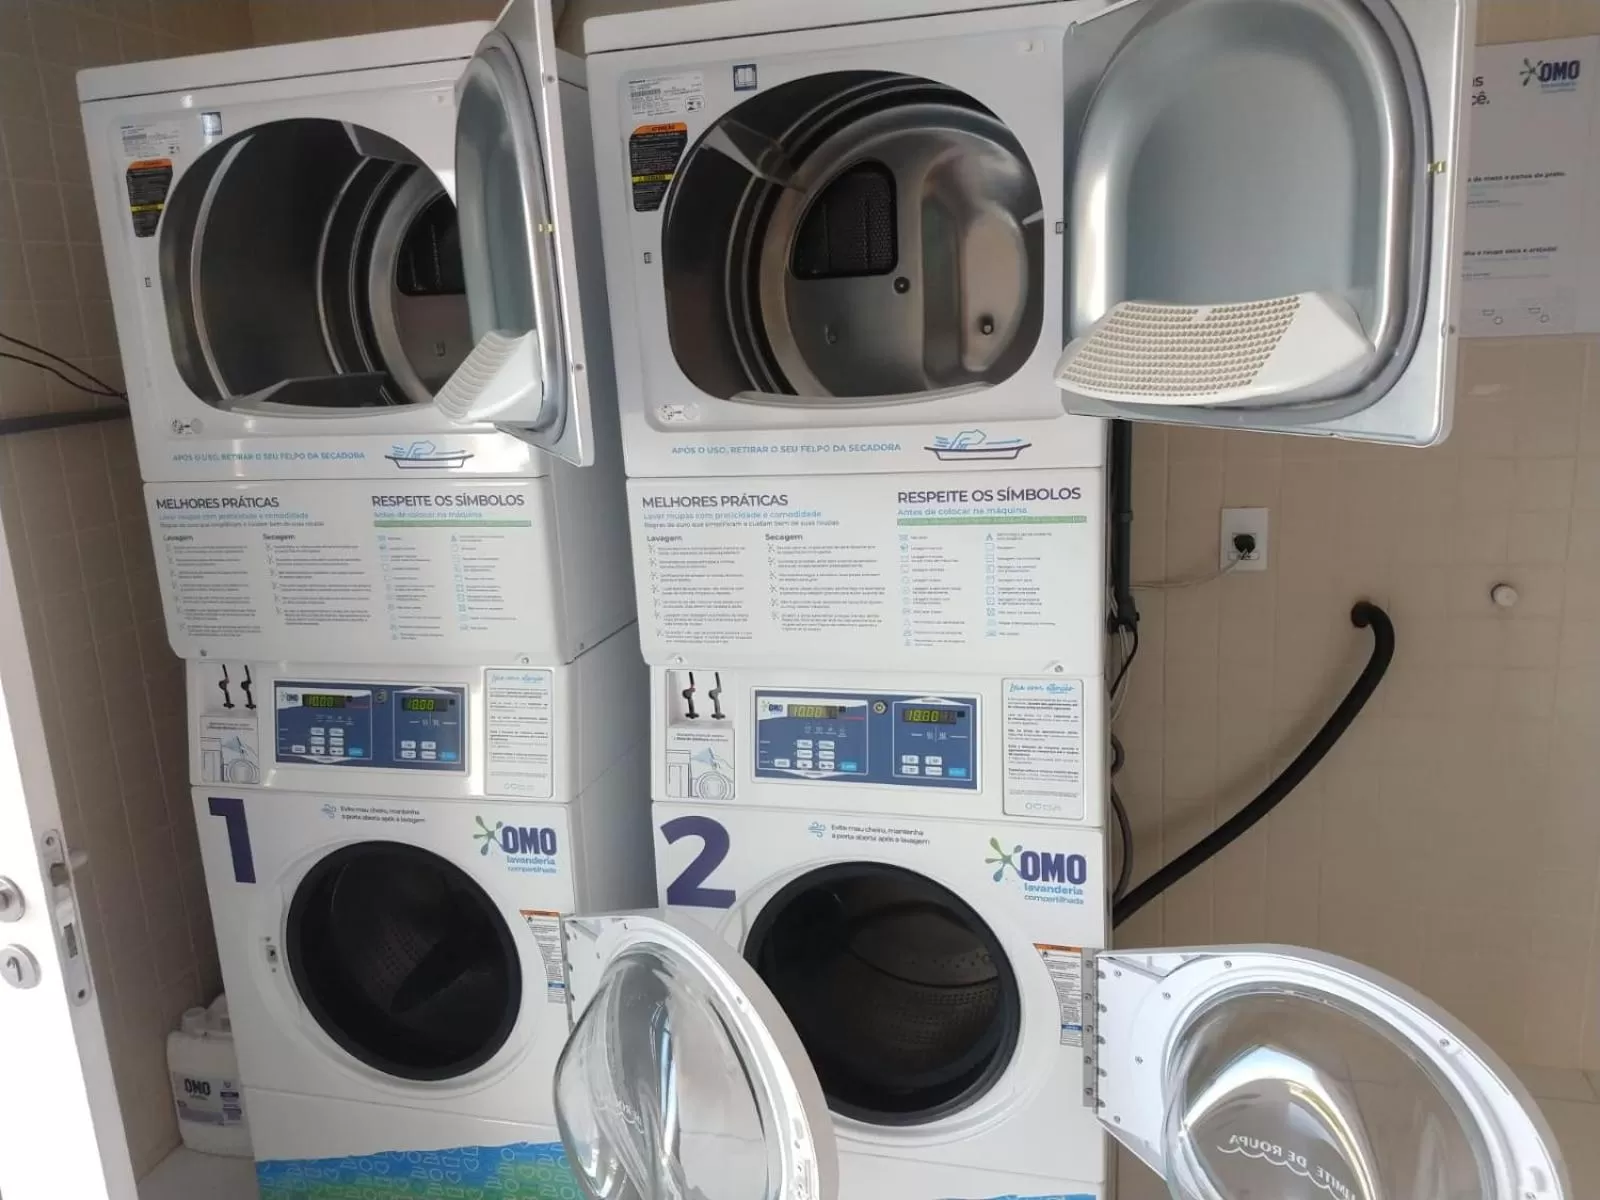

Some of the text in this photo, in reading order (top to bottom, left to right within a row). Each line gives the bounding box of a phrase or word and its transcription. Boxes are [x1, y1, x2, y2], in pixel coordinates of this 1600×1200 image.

[1541, 60, 1580, 82] OMO
[672, 443, 901, 455] APÓS O USO, RETIRAR O SEU FELPO DA SECADORA
[371, 493, 525, 507] RESPEITE OS SÍMBOLOS
[642, 493, 789, 508] MELHORES PRÁTICAS
[897, 486, 1081, 503] RESPEITE OS SÍMBOLOS
[157, 495, 280, 510] MELHORES PRÁTICAS
[647, 535, 683, 543] Lavagem
[765, 533, 803, 541] Secagem
[208, 797, 256, 884] 1
[502, 826, 557, 856] OMO
[507, 856, 556, 865] lavanderia
[660, 816, 737, 909] 2
[1020, 851, 1087, 885] OMO
[1024, 884, 1083, 895] lavanderia
[1024, 894, 1084, 905] compartilhada
[184, 1078, 211, 1097] OMO
